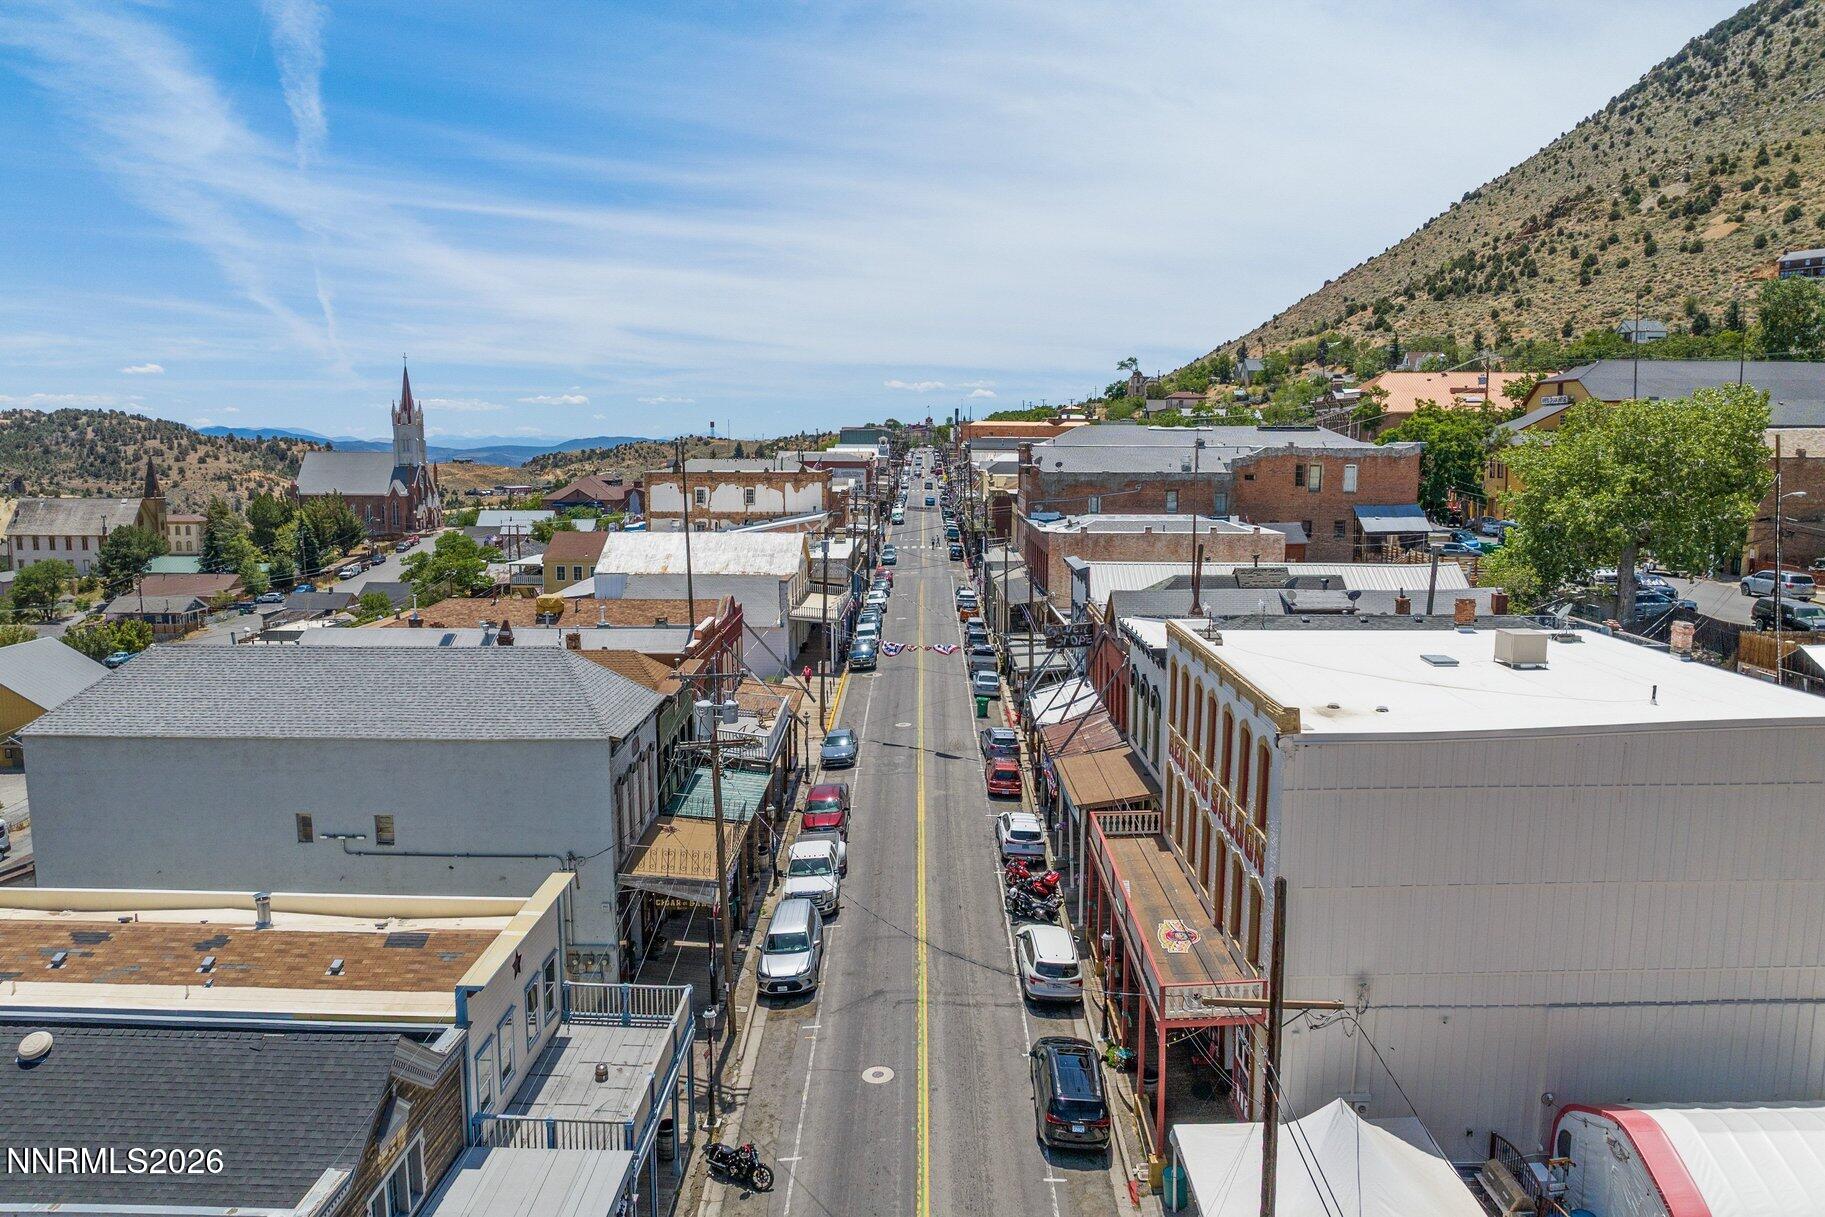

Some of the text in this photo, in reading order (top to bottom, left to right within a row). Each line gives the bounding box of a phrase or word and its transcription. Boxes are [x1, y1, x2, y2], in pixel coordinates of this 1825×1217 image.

[1168, 732, 1266, 878] RED DOG SALOON
[655, 899, 681, 907] CIGAR
